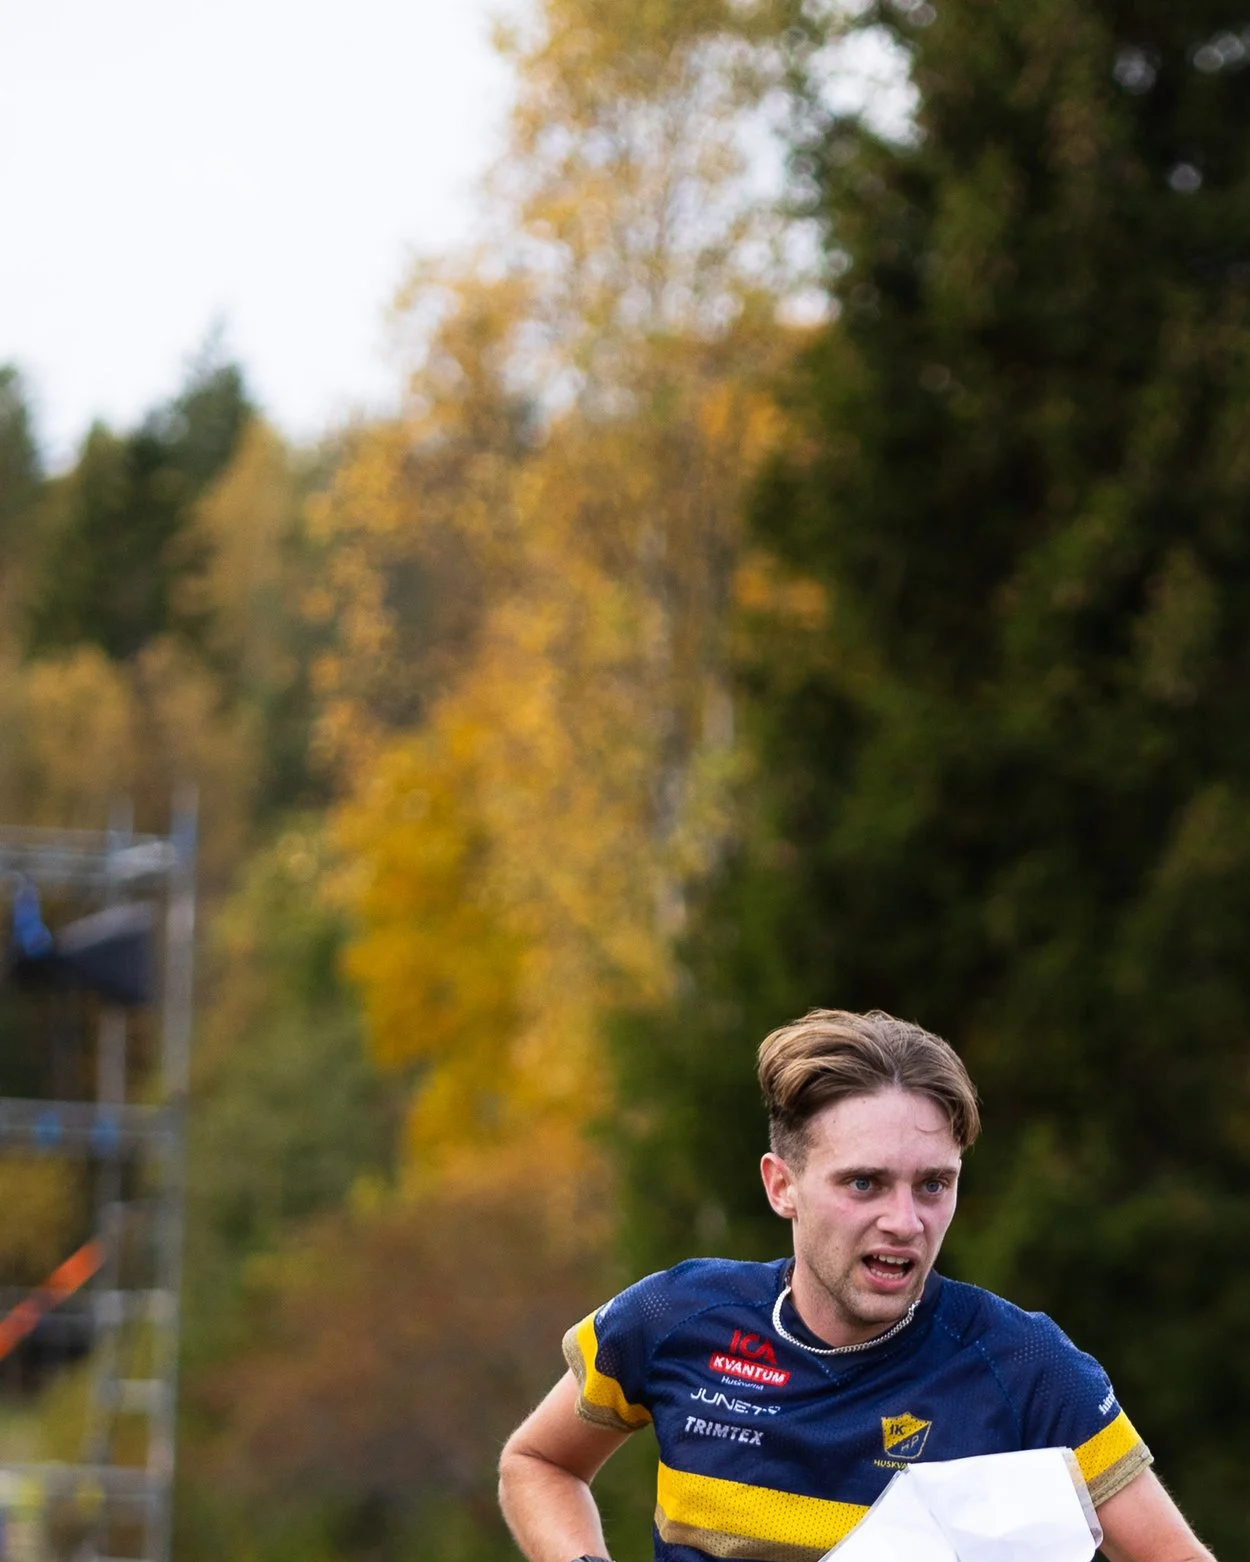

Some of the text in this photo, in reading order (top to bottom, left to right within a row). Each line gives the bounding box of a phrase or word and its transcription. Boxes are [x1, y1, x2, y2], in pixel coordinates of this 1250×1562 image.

[729, 1329, 777, 1365] ICA
[713, 1355, 786, 1384] KVANTUM
[685, 1415, 764, 1445] TRIMTEX
[889, 1424, 905, 1436] IK
